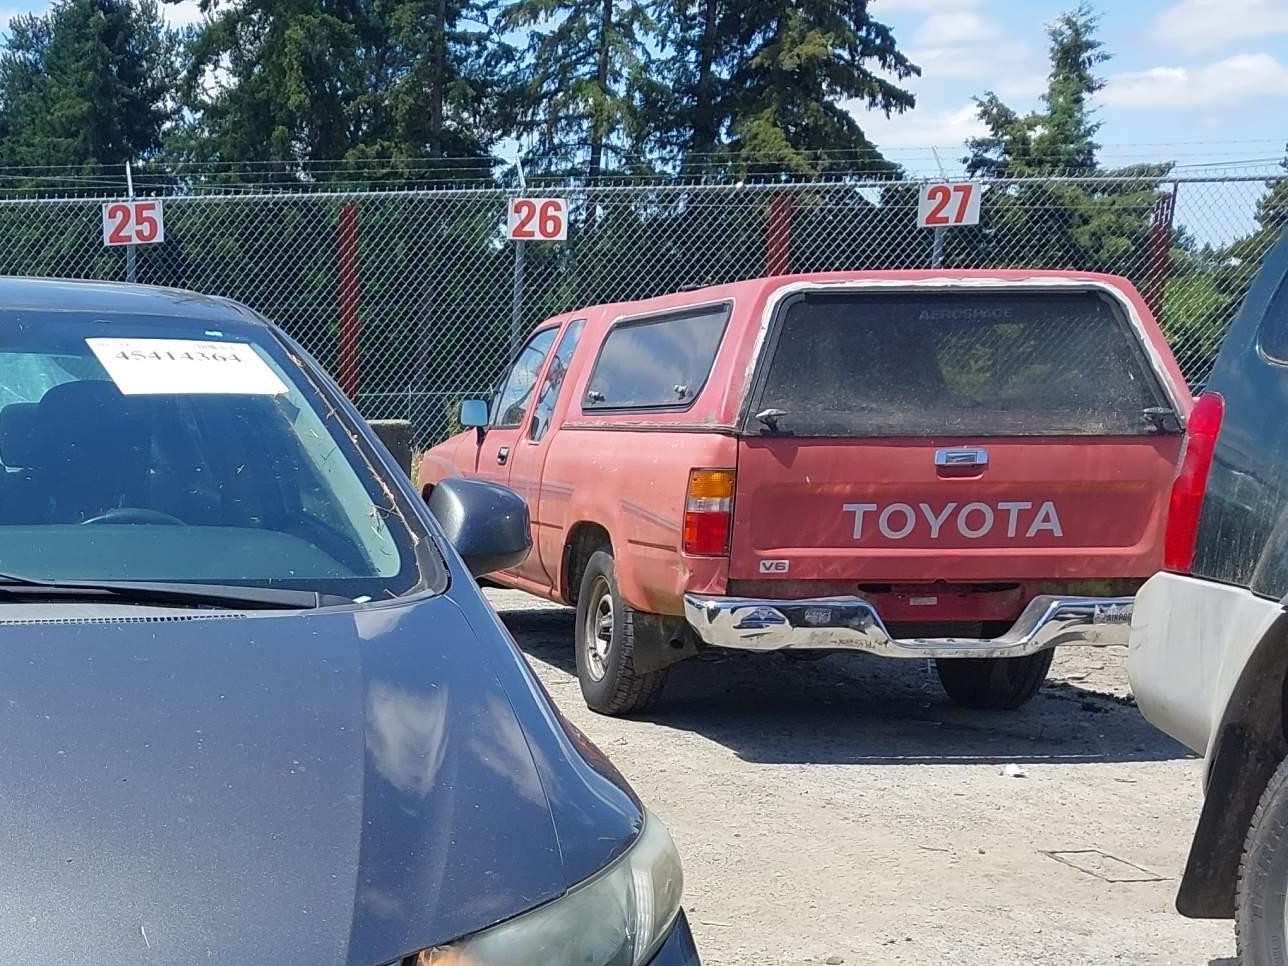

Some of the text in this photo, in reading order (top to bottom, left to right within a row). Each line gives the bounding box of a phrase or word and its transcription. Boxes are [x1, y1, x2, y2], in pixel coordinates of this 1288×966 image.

[107, 203, 159, 244] 25
[512, 199, 562, 239] 26
[925, 184, 973, 225] 27
[918, 307, 1014, 320] AEROSPACE
[115, 349, 242, 363] 45414364
[842, 501, 1064, 540] TOYOTA
[761, 561, 787, 571] V6
